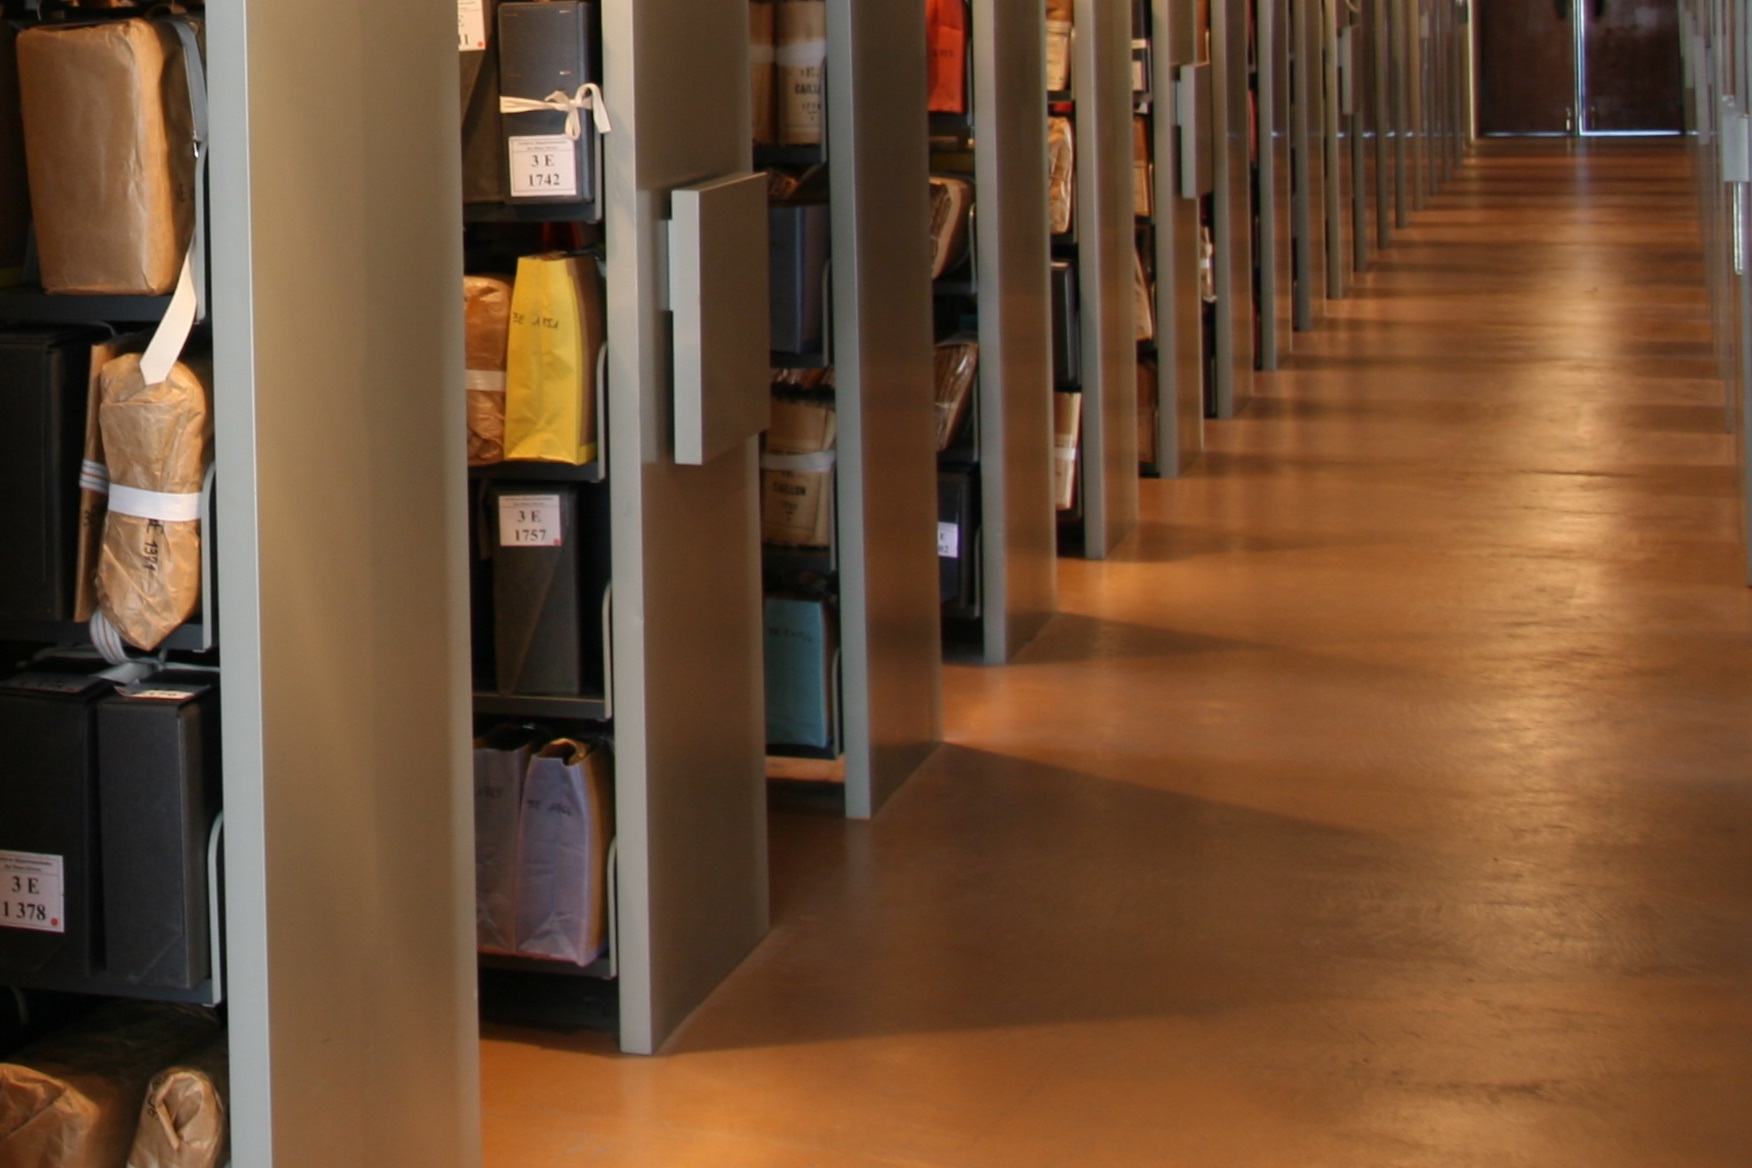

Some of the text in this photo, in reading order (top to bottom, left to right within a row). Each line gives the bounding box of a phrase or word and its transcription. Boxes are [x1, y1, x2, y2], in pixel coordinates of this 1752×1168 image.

[531, 154, 555, 167] 3 E
[528, 174, 560, 187] 1742
[518, 510, 541, 523] 3 E
[515, 529, 546, 541] 1757
[11, 876, 40, 894] 3 E
[16, 902, 46, 921] 378
